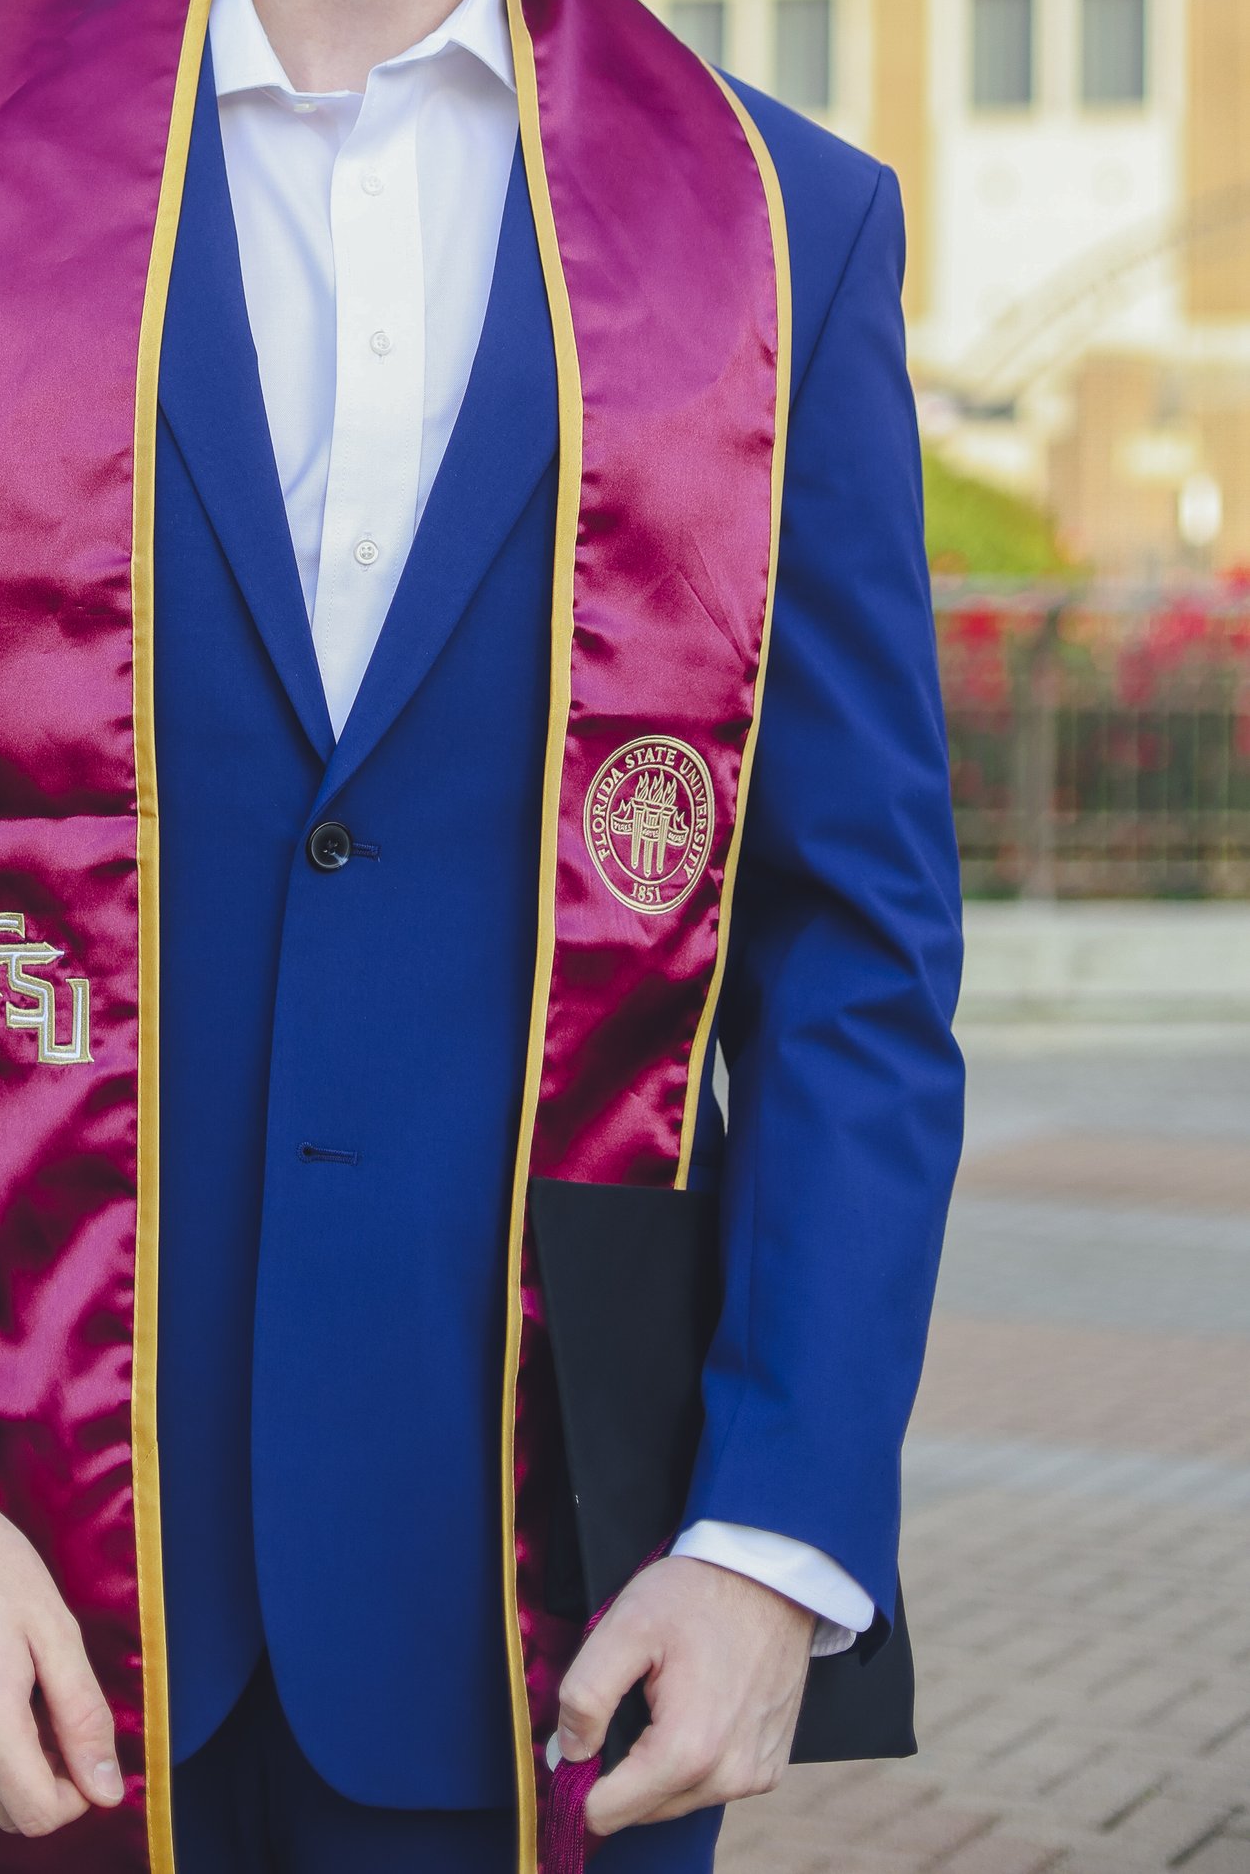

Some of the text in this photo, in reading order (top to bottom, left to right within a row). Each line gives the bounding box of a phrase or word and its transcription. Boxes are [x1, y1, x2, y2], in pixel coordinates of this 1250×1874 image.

[592, 746, 707, 879] FLORIDA STATE UNIVERSITY
[630, 882, 662, 903] 1851
